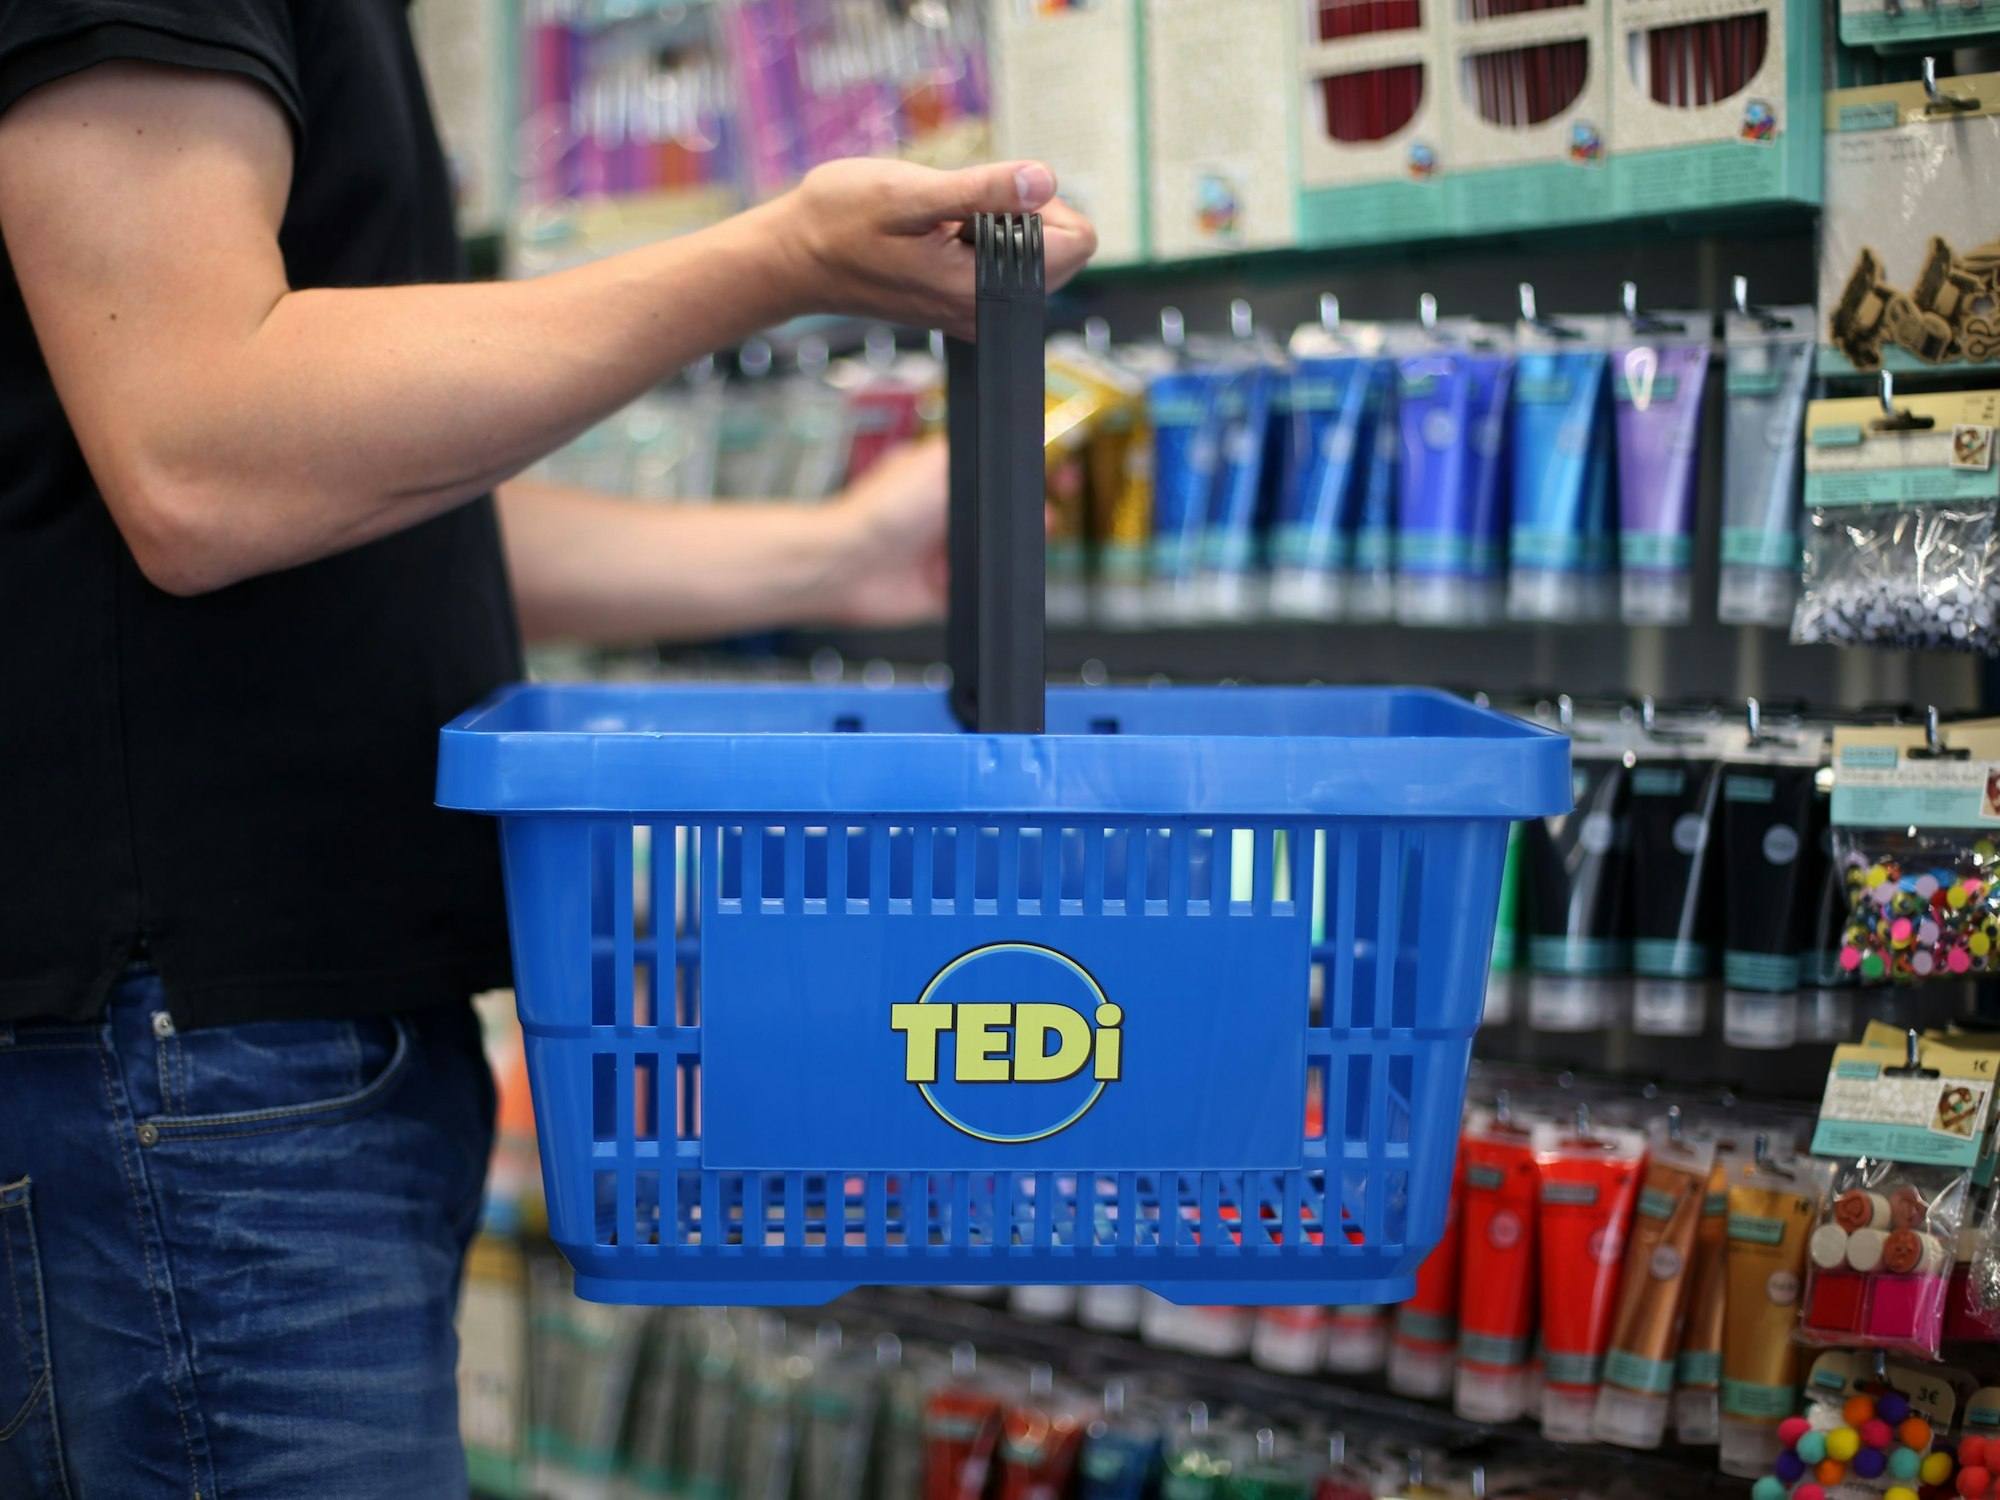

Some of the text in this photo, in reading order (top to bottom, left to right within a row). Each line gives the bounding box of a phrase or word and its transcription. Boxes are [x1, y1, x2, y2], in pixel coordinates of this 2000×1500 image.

[890, 1002, 1124, 1083] TEDi
[1973, 1060, 1989, 1073] 1€
[1918, 1388, 1940, 1405] 3€
